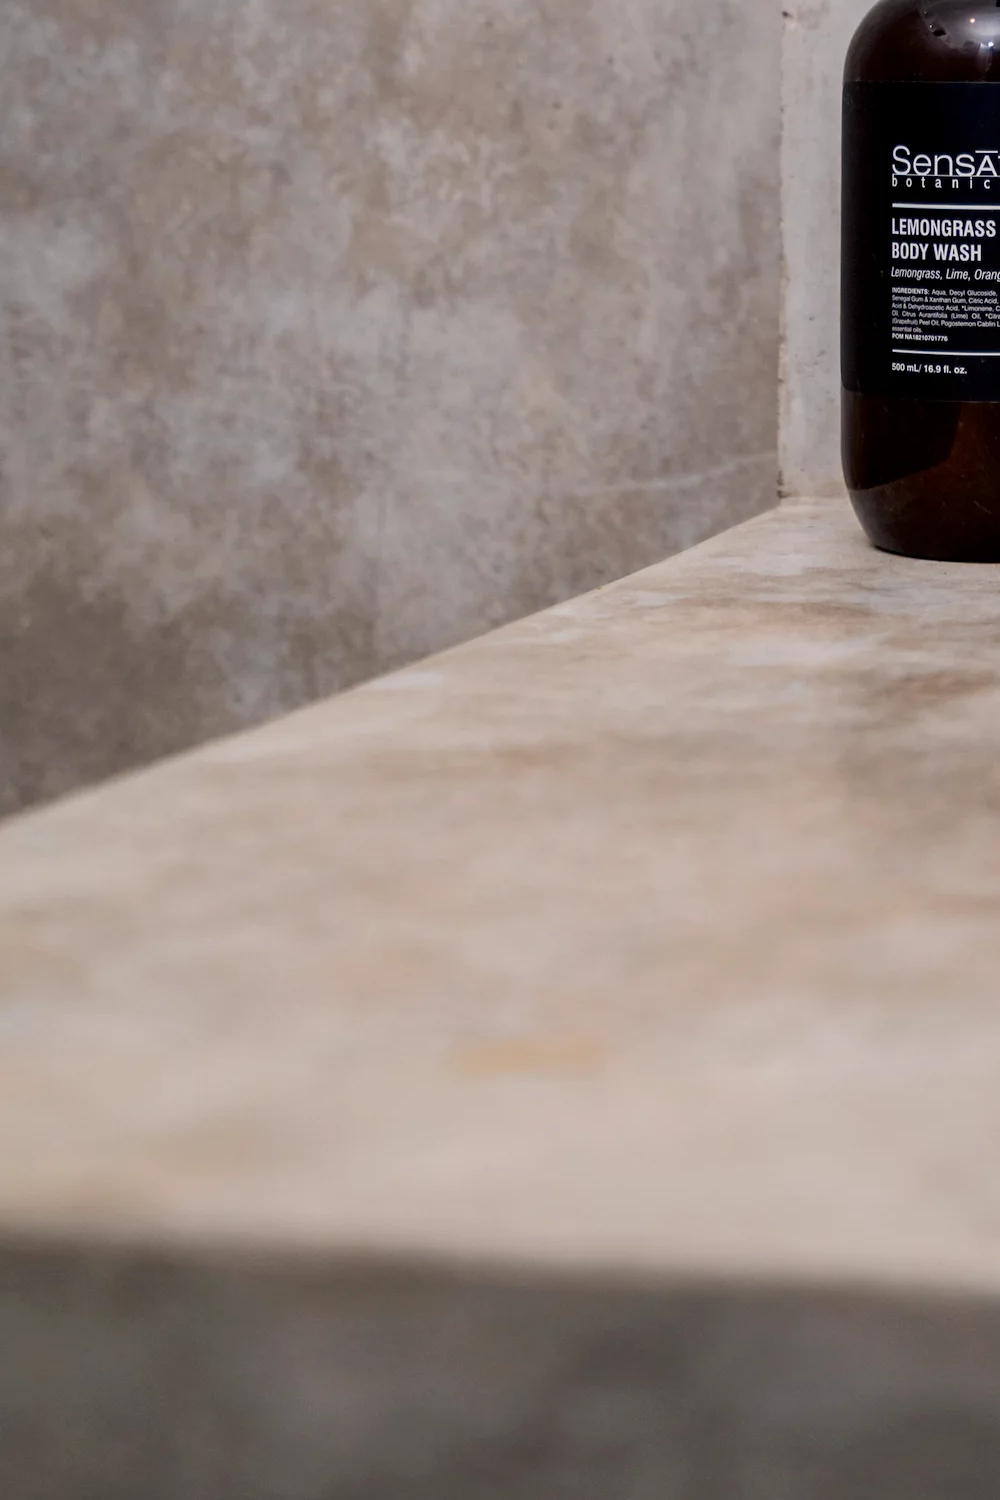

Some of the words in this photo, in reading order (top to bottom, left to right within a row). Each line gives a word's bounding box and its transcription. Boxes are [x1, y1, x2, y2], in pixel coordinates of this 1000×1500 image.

[892, 218, 996, 238] LEMONGRASS
[892, 242, 929, 260] BODY
[934, 244, 982, 262] WASH
[891, 266, 943, 281] Lemongrass,
[946, 268, 971, 281] Lime,
[892, 287, 930, 295] INGREDIENTS:
[941, 320, 976, 328] Pogostemon
[892, 362, 905, 371] 500
[907, 364, 922, 373] mL/
[924, 365, 941, 374] 16.9
[943, 365, 952, 374] fl.
